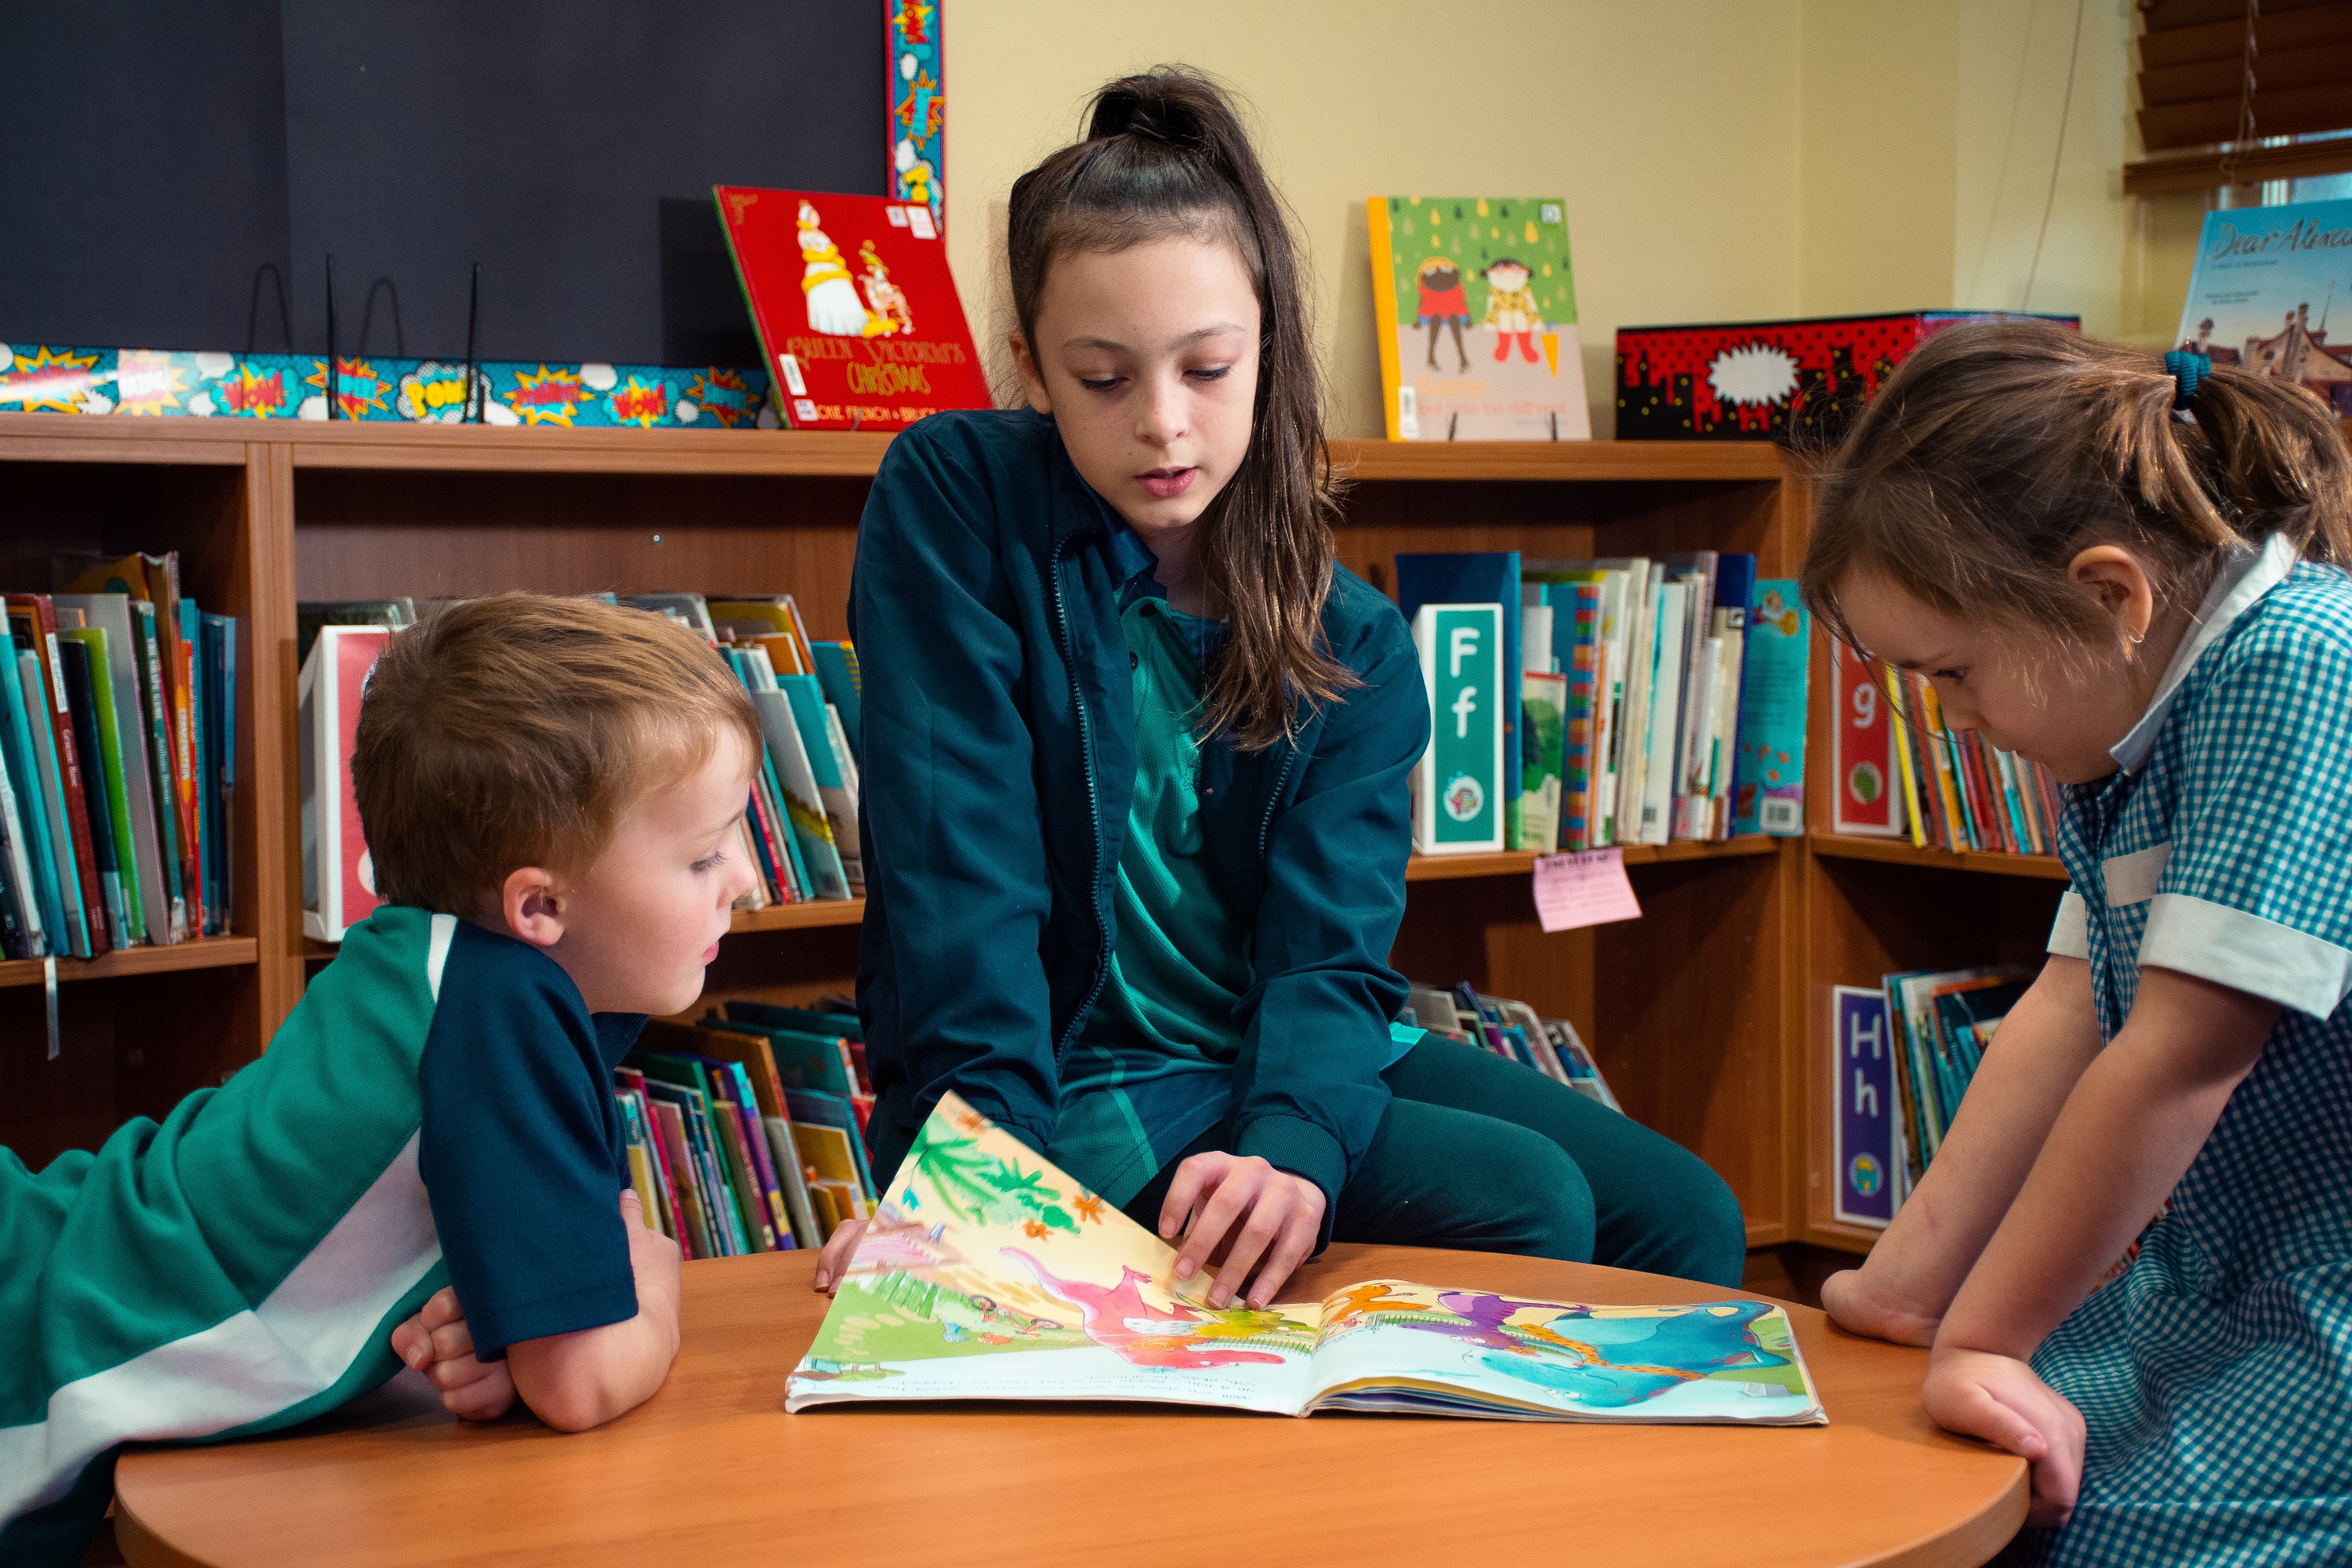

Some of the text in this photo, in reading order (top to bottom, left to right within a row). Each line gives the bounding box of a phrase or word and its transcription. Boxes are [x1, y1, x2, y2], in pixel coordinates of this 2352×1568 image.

[2213, 223, 2278, 260] Dear
[1450, 628, 1479, 677] F
[1451, 686, 1477, 738] f
[1853, 683, 1876, 728] g
[1850, 1011, 1882, 1059] H
[1854, 1069, 1879, 1118] h
